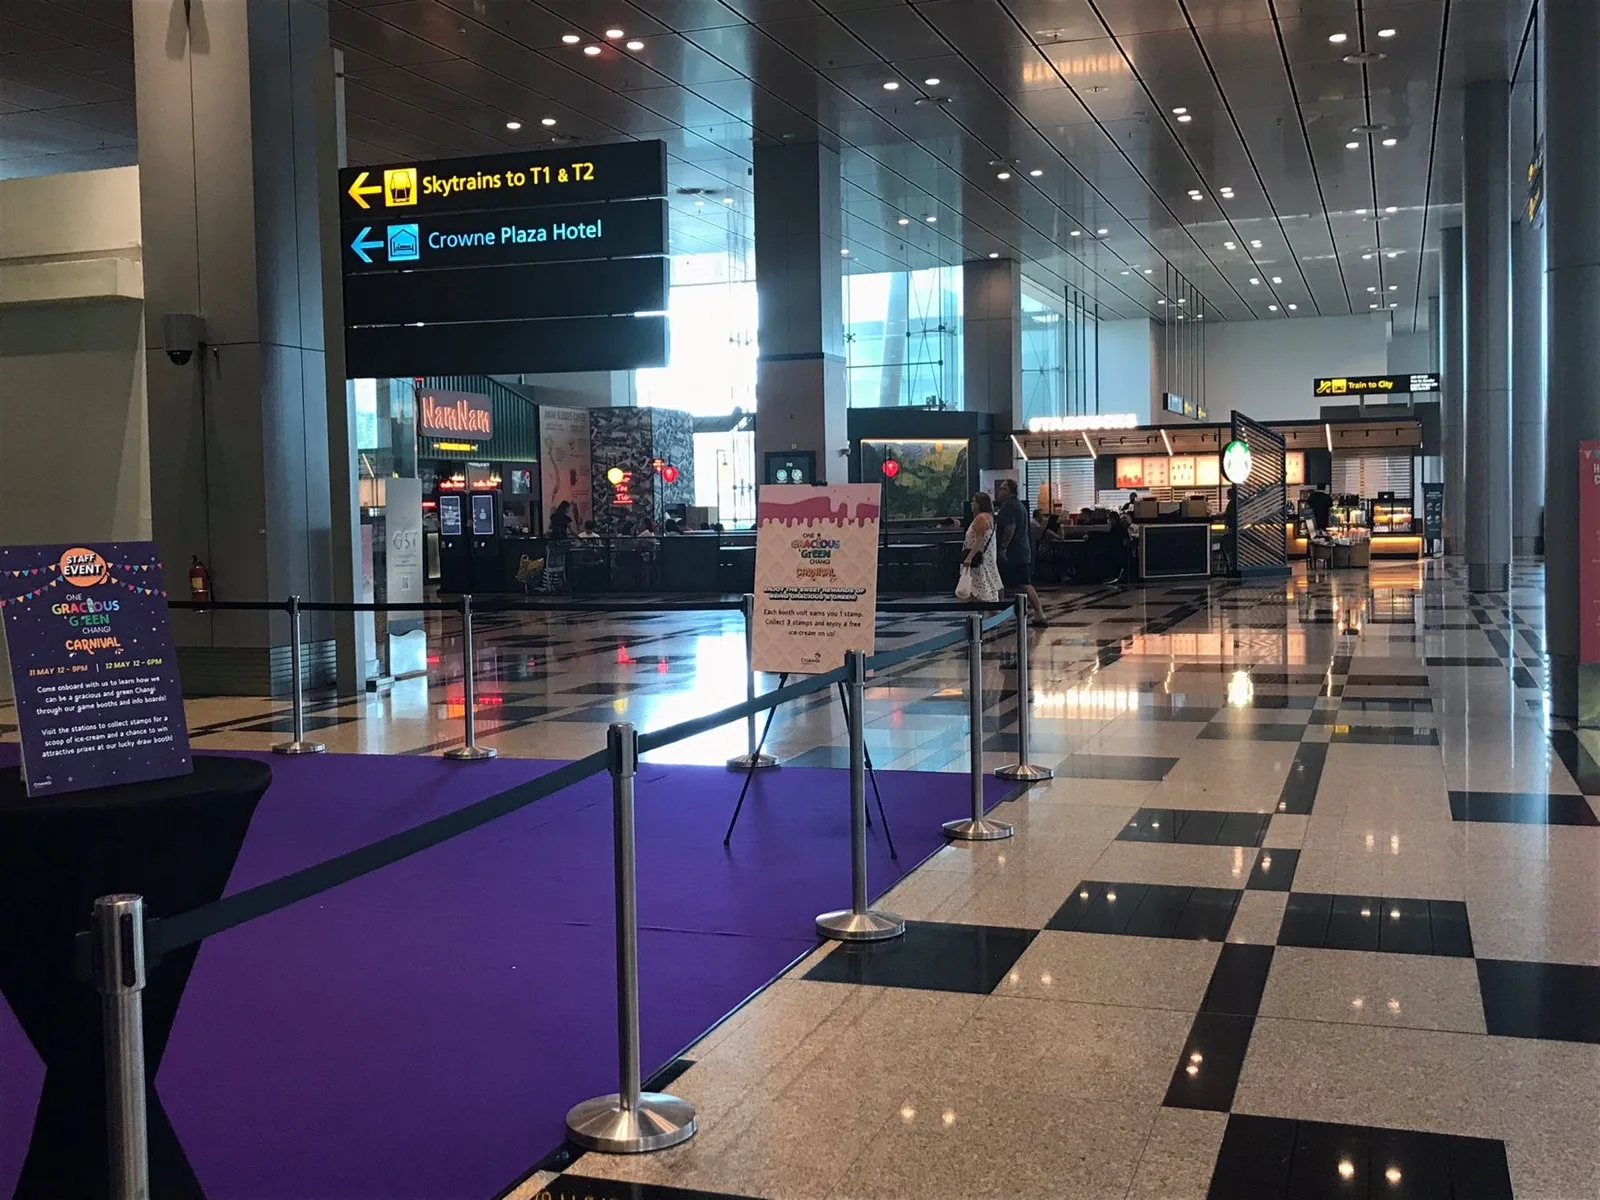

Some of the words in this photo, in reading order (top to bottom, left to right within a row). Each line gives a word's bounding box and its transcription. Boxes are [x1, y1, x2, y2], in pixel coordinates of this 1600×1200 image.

[422, 171, 501, 197] Skytrains
[506, 170, 525, 186] to
[530, 166, 550, 184] T1
[558, 168, 568, 182] &
[572, 162, 594, 181] T2
[428, 232, 495, 248] Crowne
[501, 226, 546, 244] Plaza
[553, 219, 602, 240] Hotel
[1378, 381, 1393, 389] City
[422, 396, 490, 433] NamNam
[791, 538, 841, 549] GRACIOUS
[66, 554, 94, 564] STAFF
[64, 564, 101, 575] EVENT
[52, 598, 120, 615] GRACIOUS
[83, 626, 111, 634] CHANGI
[66, 637, 121, 654] CARNIVAL
[36, 668, 55, 676] MAY
[72, 665, 88, 673] 9PM
[58, 682, 84, 691] onboard
[74, 692, 101, 702] gracious
[116, 689, 134, 697] green
[135, 685, 156, 695] Changi
[36, 707, 62, 716] through
[77, 704, 94, 713] game
[107, 720, 128, 728] collect
[130, 718, 152, 726] stamps
[74, 734, 106, 743] ice-cream
[125, 728, 147, 736] chance
[42, 748, 75, 758] attractive
[76, 746, 96, 754] prizes
[118, 740, 135, 748] lucky
[154, 735, 173, 743] booth!
